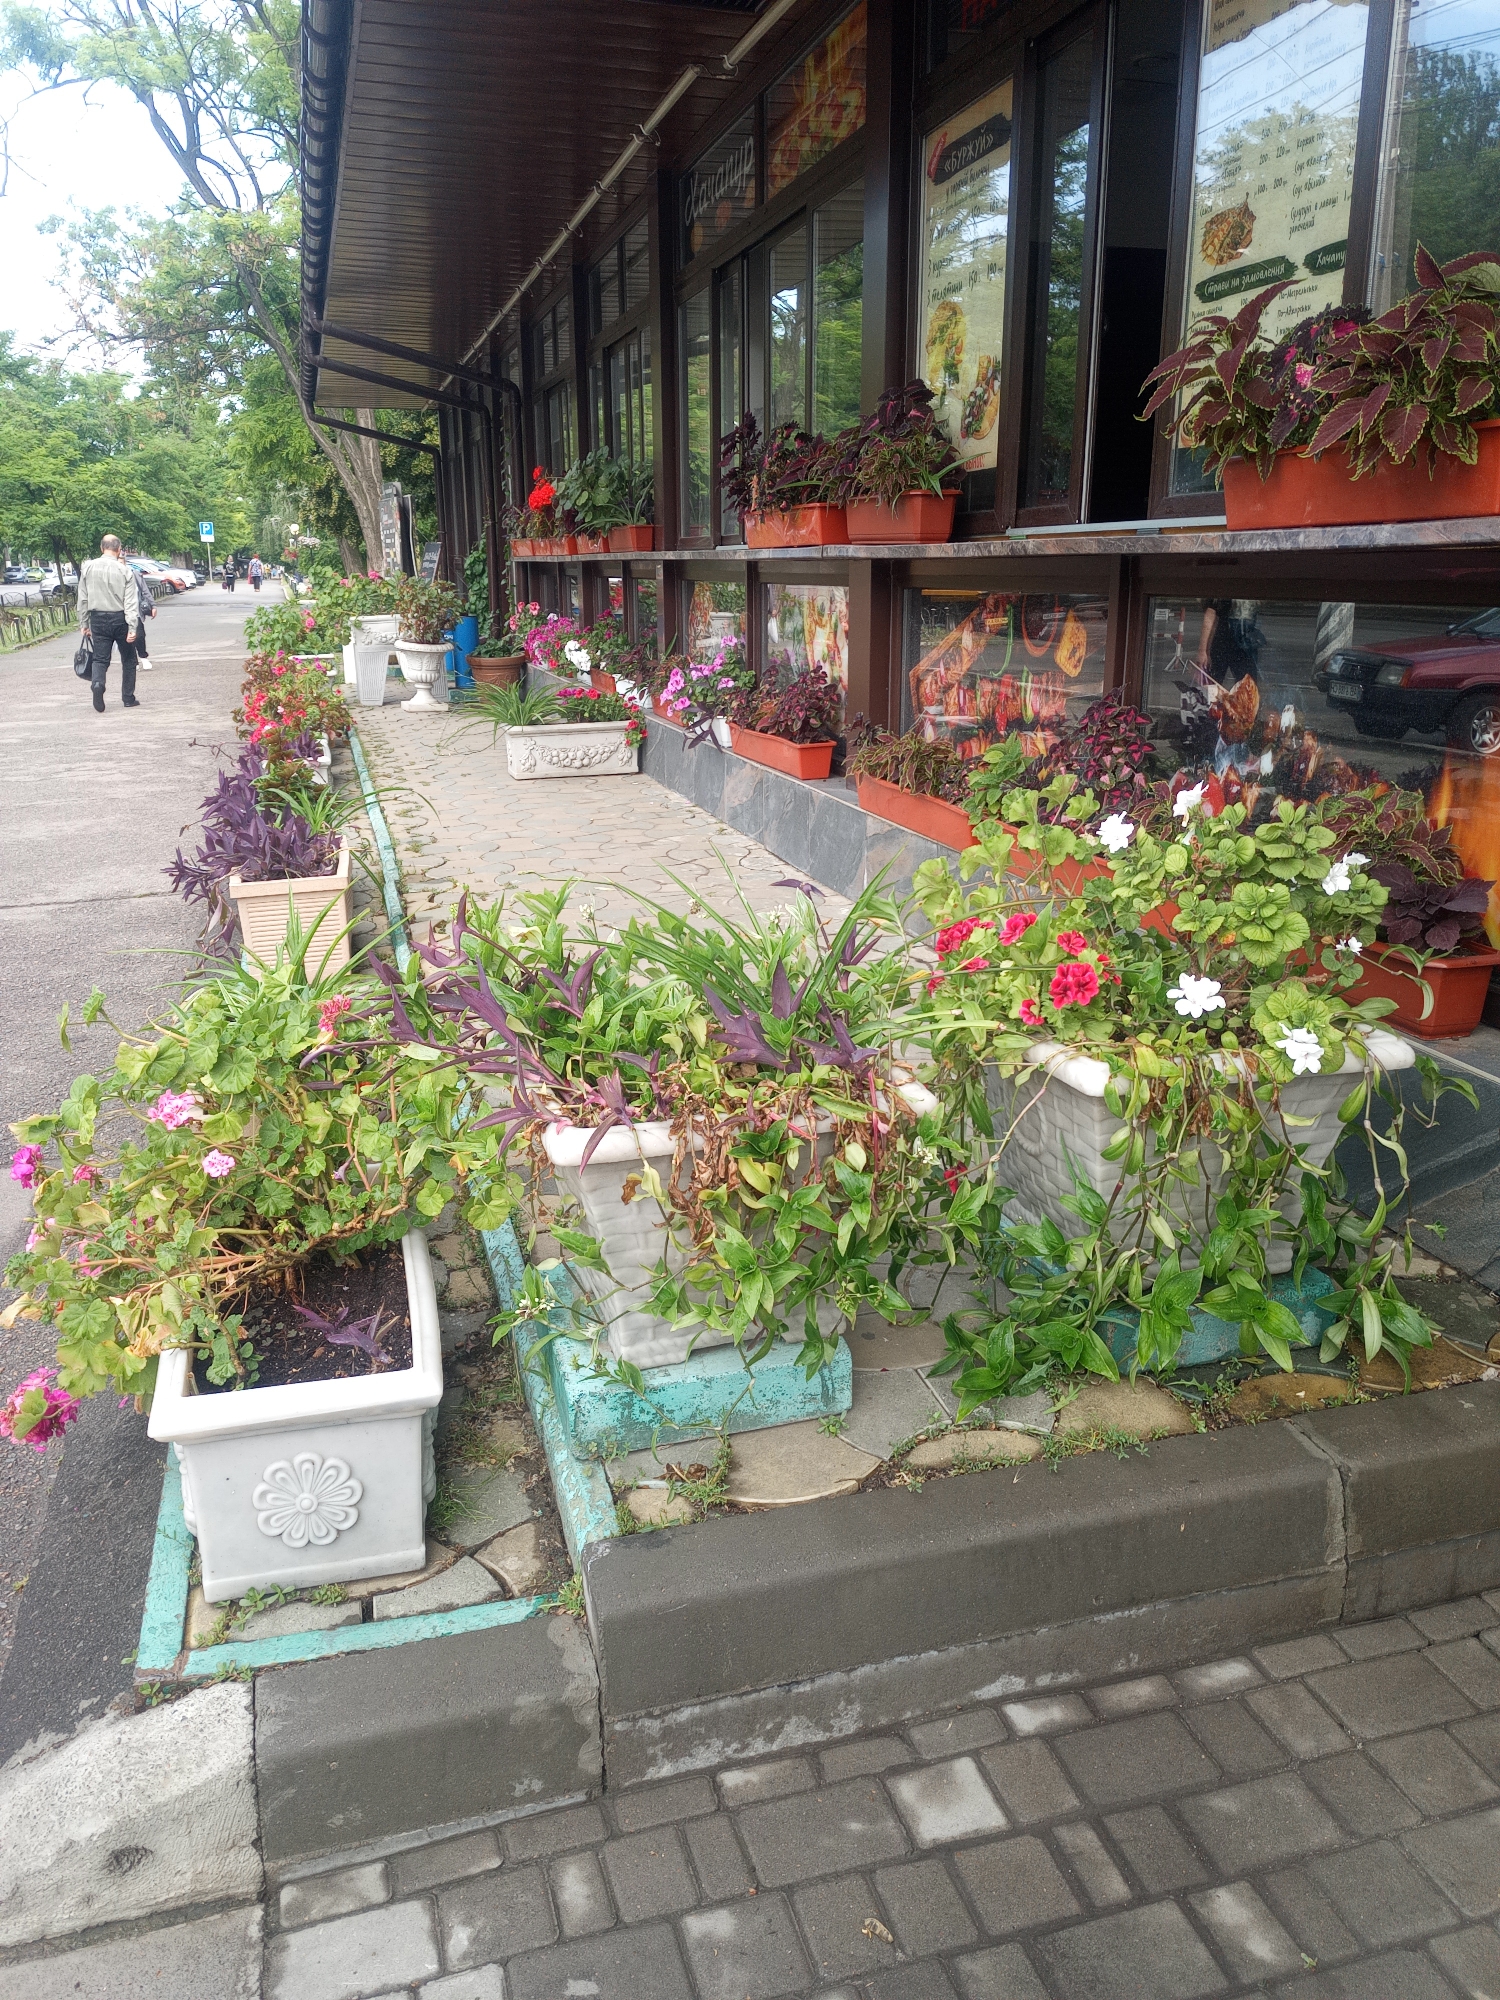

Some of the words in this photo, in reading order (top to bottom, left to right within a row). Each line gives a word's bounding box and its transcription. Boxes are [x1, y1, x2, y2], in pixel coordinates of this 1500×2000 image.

[1204, 281, 1230, 299] Страви
[1230, 277, 1240, 289] на
[1240, 262, 1286, 291] замовлення
[202, 523, 211, 534] P
